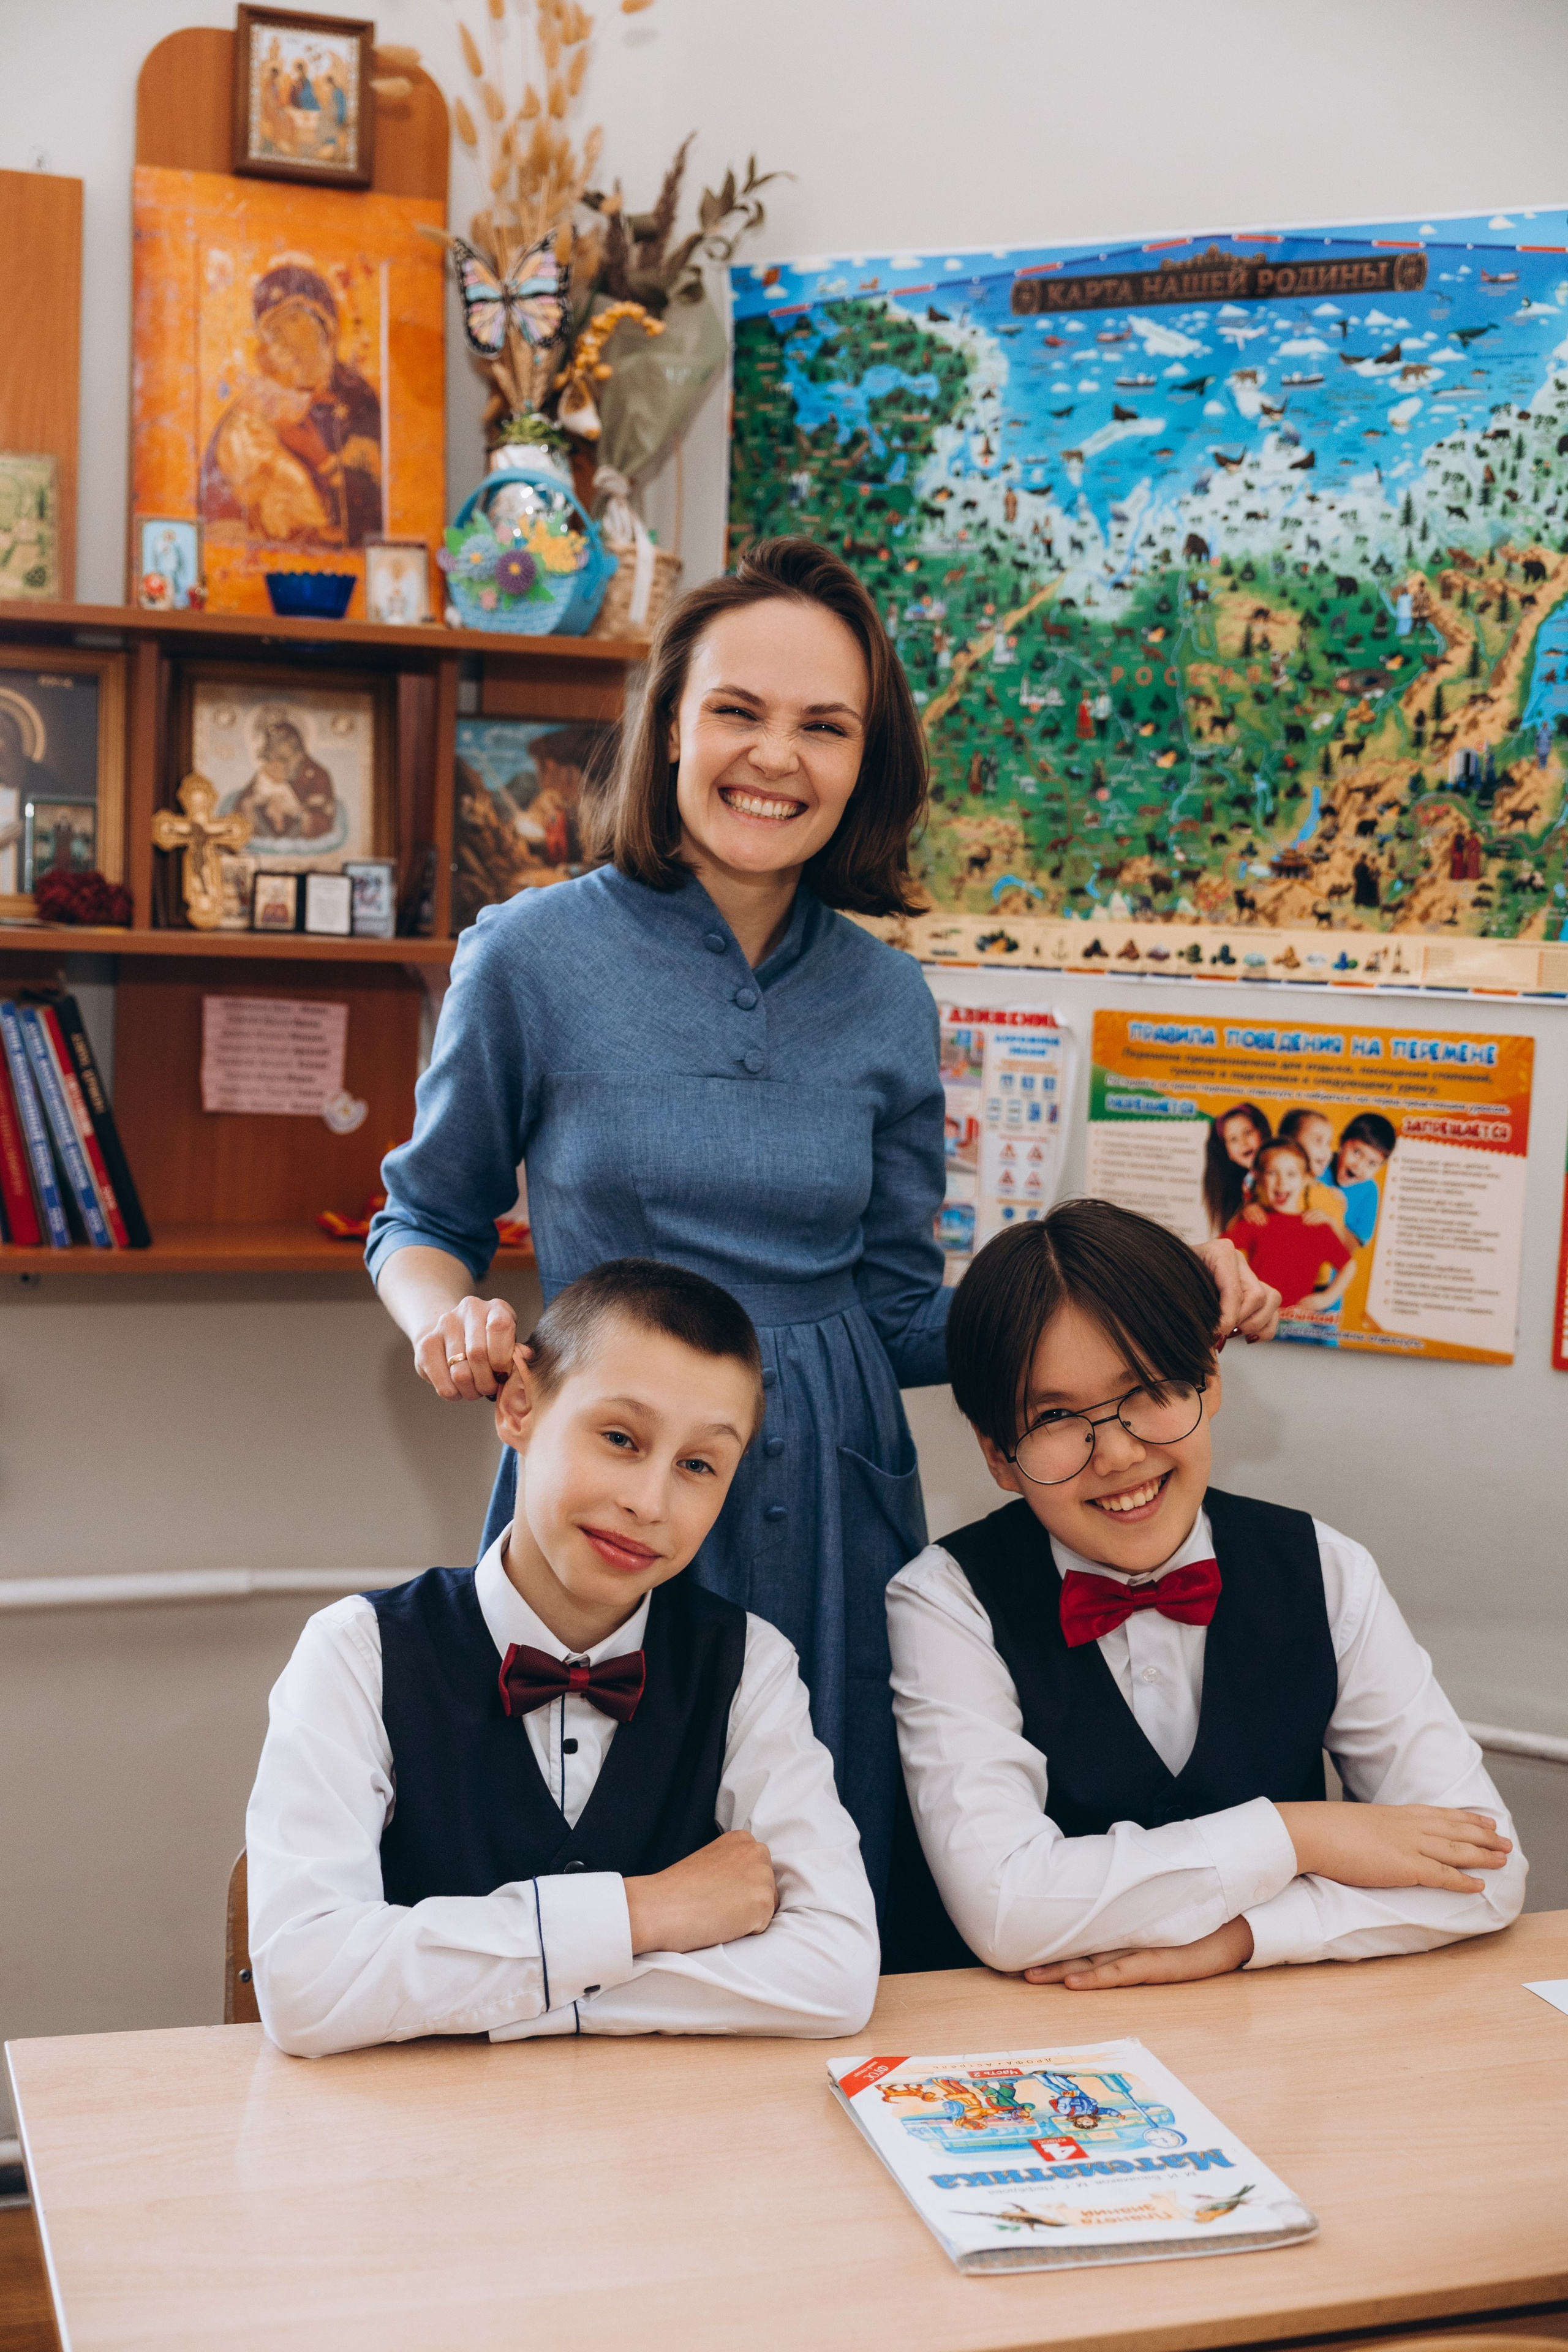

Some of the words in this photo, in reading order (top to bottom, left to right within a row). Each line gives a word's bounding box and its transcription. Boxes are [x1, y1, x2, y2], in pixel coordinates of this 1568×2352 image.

[1046, 279, 1133, 307] КАРТА
[1142, 266, 1248, 299] НАШЕЙ
[1257, 262, 1389, 294] РОДИНЫ
[1129, 1022, 1216, 1046] ПРАВИЛА
[1225, 1029, 1343, 1054] ПОВЕДЕНИЯ
[1351, 1035, 1381, 1057] НА
[1392, 1039, 1496, 1066] ПЕРЕМЕНЕ
[1405, 1118, 1509, 1141] ЗАПРЕЩАЕТСЯ
[863, 2064, 889, 2082] ФГОС
[983, 2069, 1019, 2078] Часть
[1040, 2144, 1076, 2160] 4
[929, 2149, 1236, 2190] Математика
[1080, 2203, 1156, 2217] знаний
[1080, 2210, 1174, 2226] Планета
